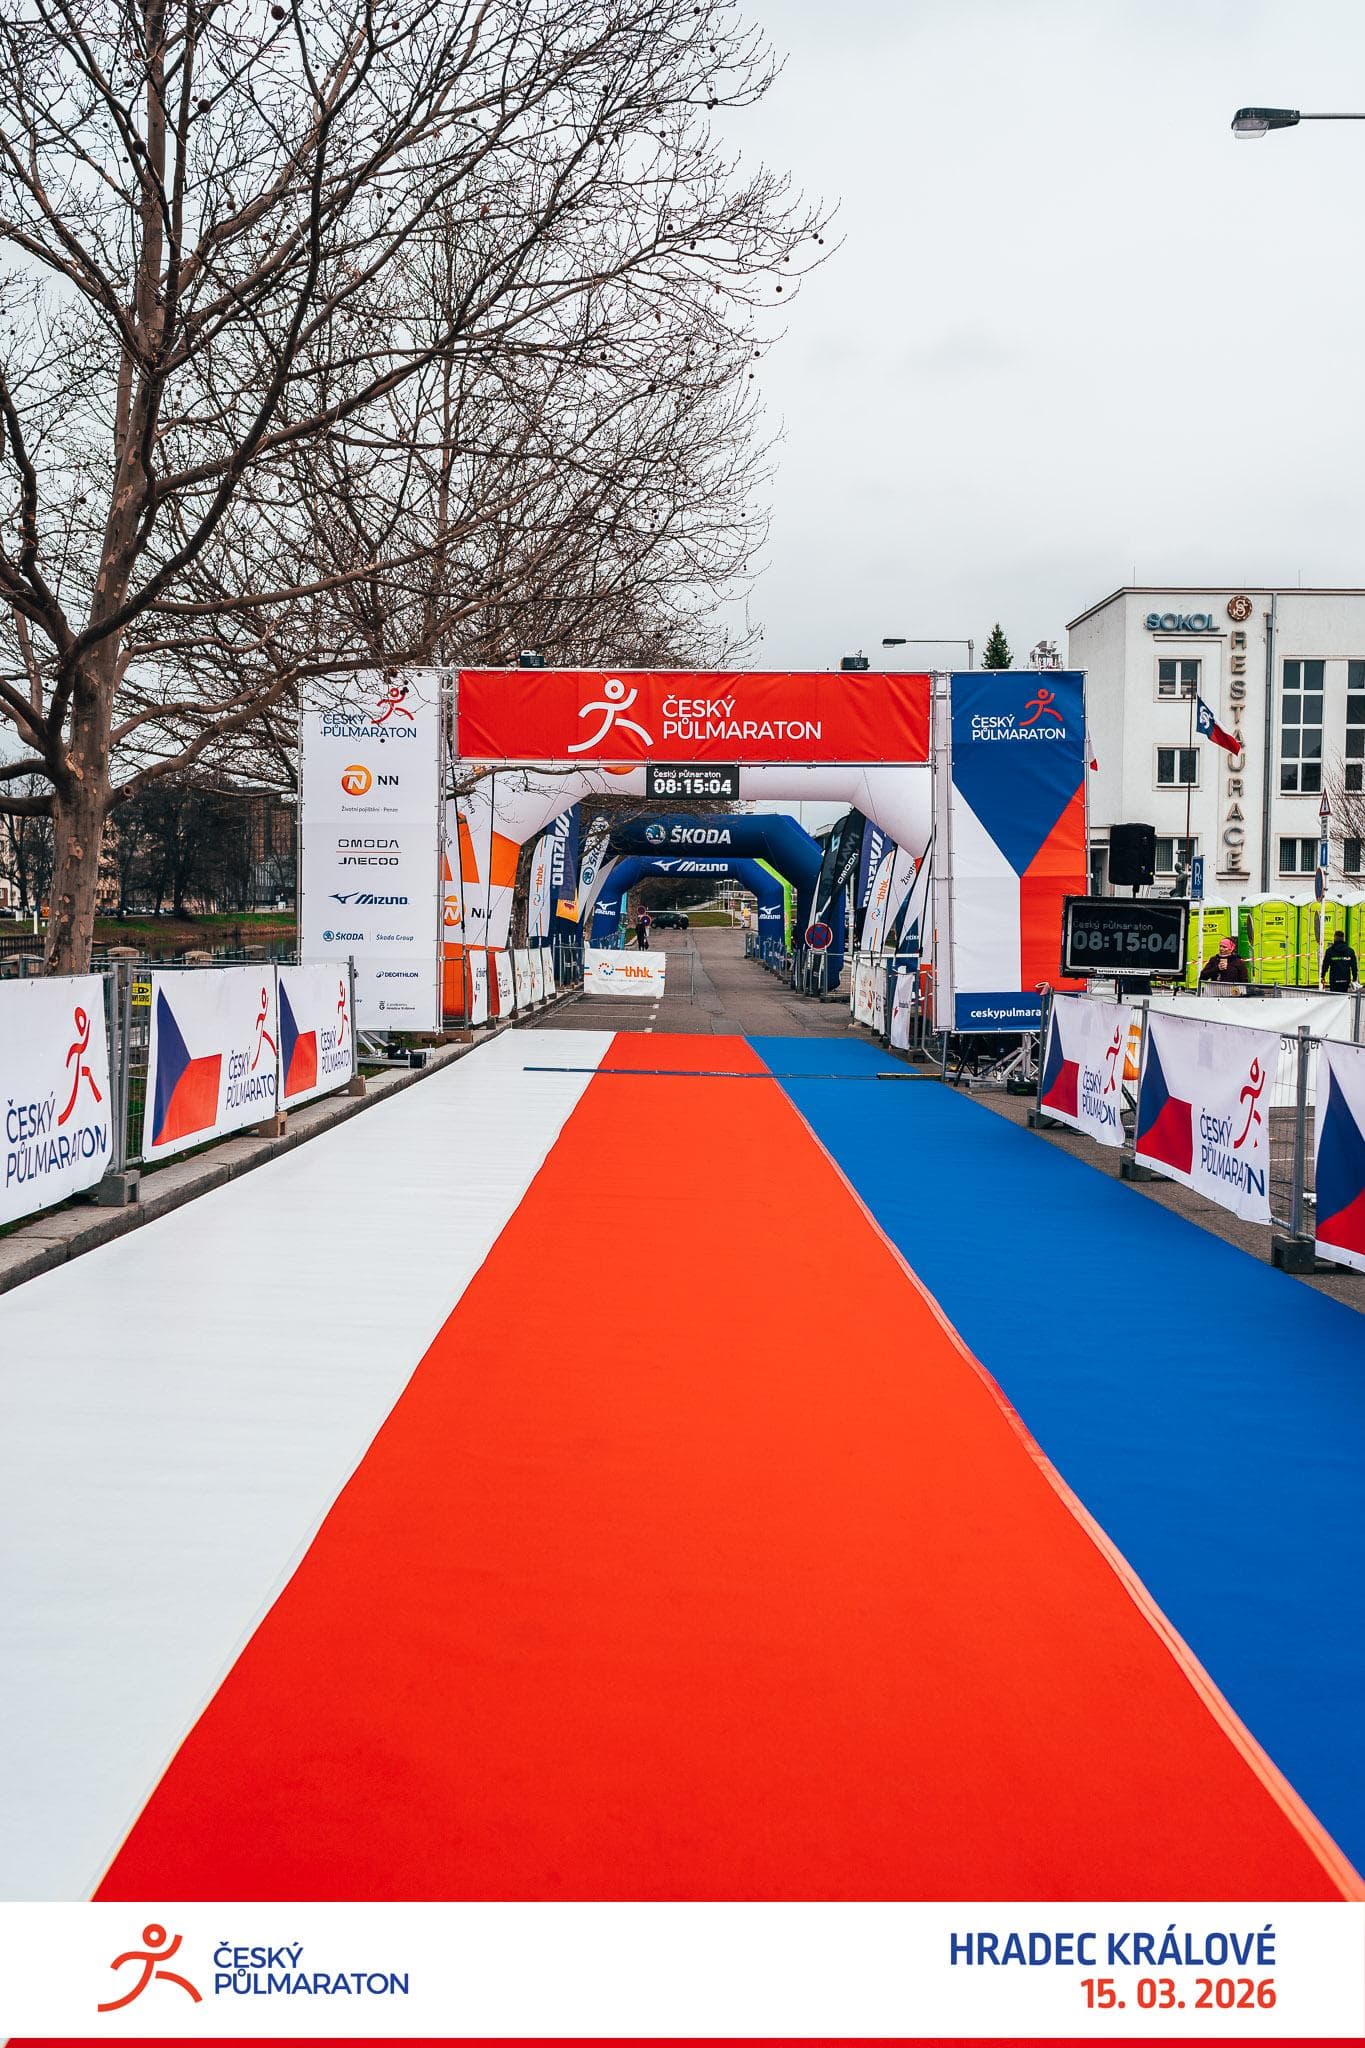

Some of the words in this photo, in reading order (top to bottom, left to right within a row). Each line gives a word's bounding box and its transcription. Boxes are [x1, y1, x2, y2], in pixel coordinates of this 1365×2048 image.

[1146, 612, 1221, 631] SOKOL
[662, 694, 736, 718] ČESKÝ
[663, 717, 822, 740] PŮLMARATON
[971, 714, 1015, 728] ČESKÝ
[323, 724, 417, 738] PŮLMARATON
[972, 728, 1066, 741] PŮLMARATON
[1224, 631, 1247, 871] RESTAURACE
[377, 775, 399, 785] NN
[654, 769, 677, 779] Český
[679, 769, 721, 779] půlmaraton
[654, 779, 732, 795] 08:15:04
[338, 839, 399, 848] OMODA
[670, 825, 731, 844] ŠKODA
[338, 857, 399, 865] JAECOO
[677, 861, 728, 872] MIZUNO
[837, 854, 859, 885] OMODA
[355, 894, 409, 905] MIZUNO
[1073, 920, 1100, 930] Český
[336, 931, 364, 941] ŠKODA
[376, 933, 395, 941] Škoda
[395, 934, 414, 942] Group
[1073, 930, 1178, 953] 08:15:04
[228, 1046, 251, 1080] ČESKÝ
[1083, 1065, 1102, 1094] ČESKÝ
[226, 1073, 276, 1110] PŮLMARATO
[7, 1091, 56, 1143] ČESKÝ
[1200, 1108, 1232, 1147] ČESKÝ
[6, 1124, 107, 1188] PŮLMARATON
